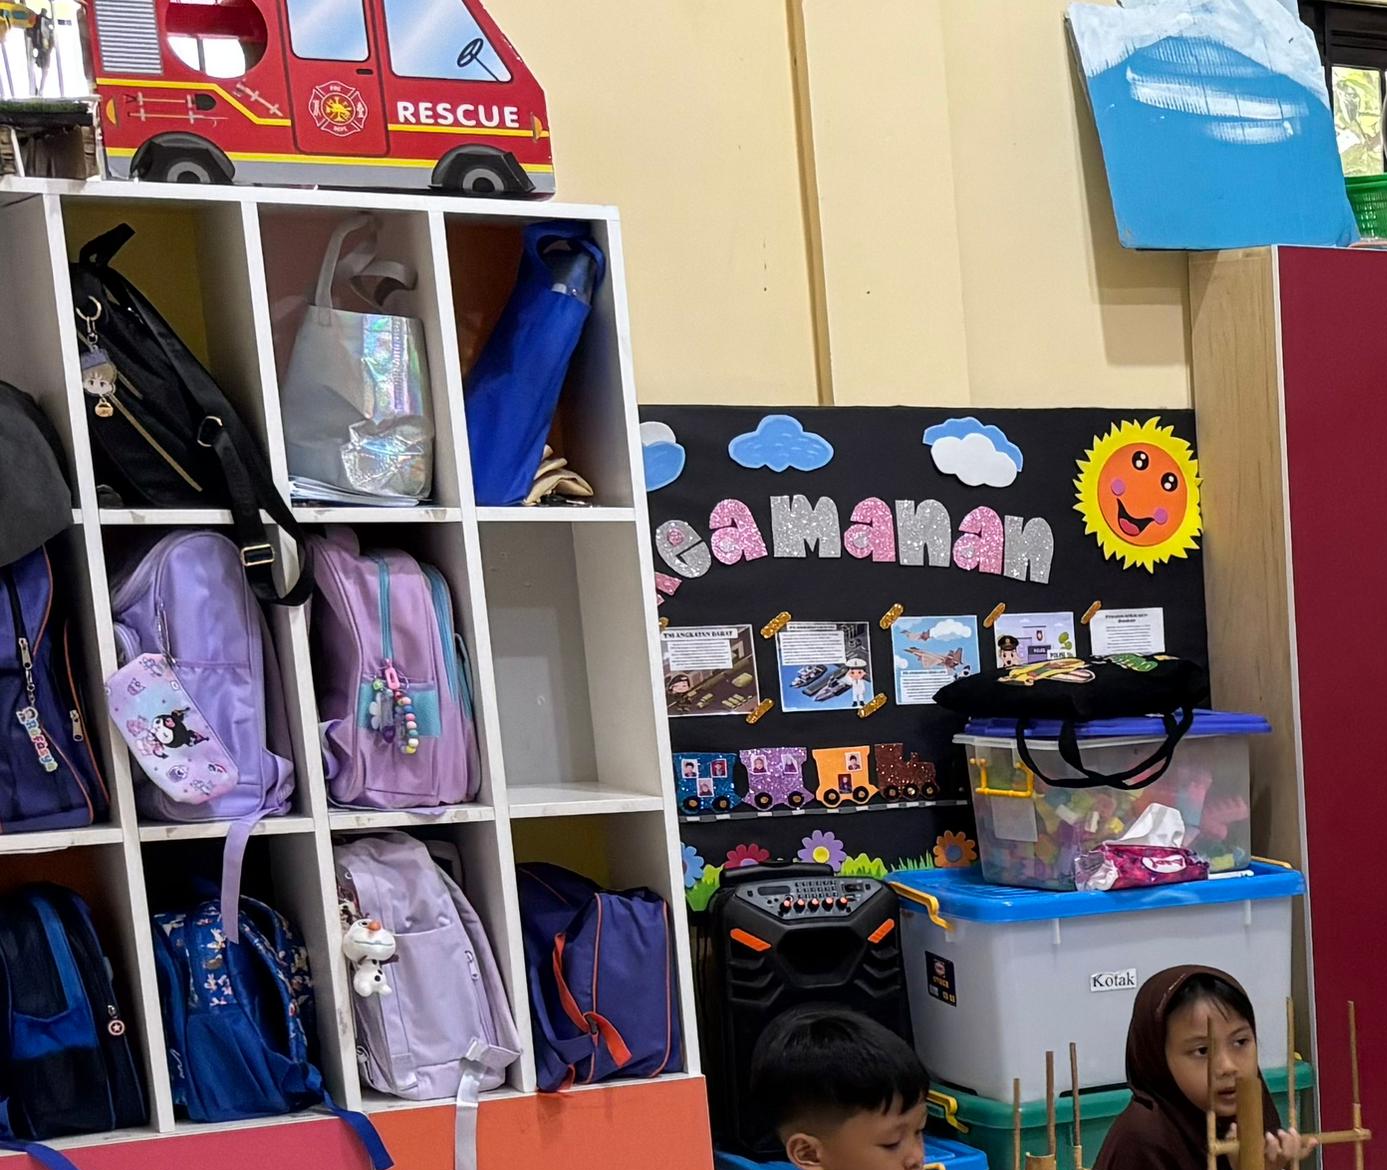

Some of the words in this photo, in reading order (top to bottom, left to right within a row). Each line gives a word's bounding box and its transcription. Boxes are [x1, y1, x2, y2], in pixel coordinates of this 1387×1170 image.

[397, 101, 520, 128] RESCUE
[655, 494, 1054, 606] eamanan
[1092, 971, 1135, 987] Kotak
